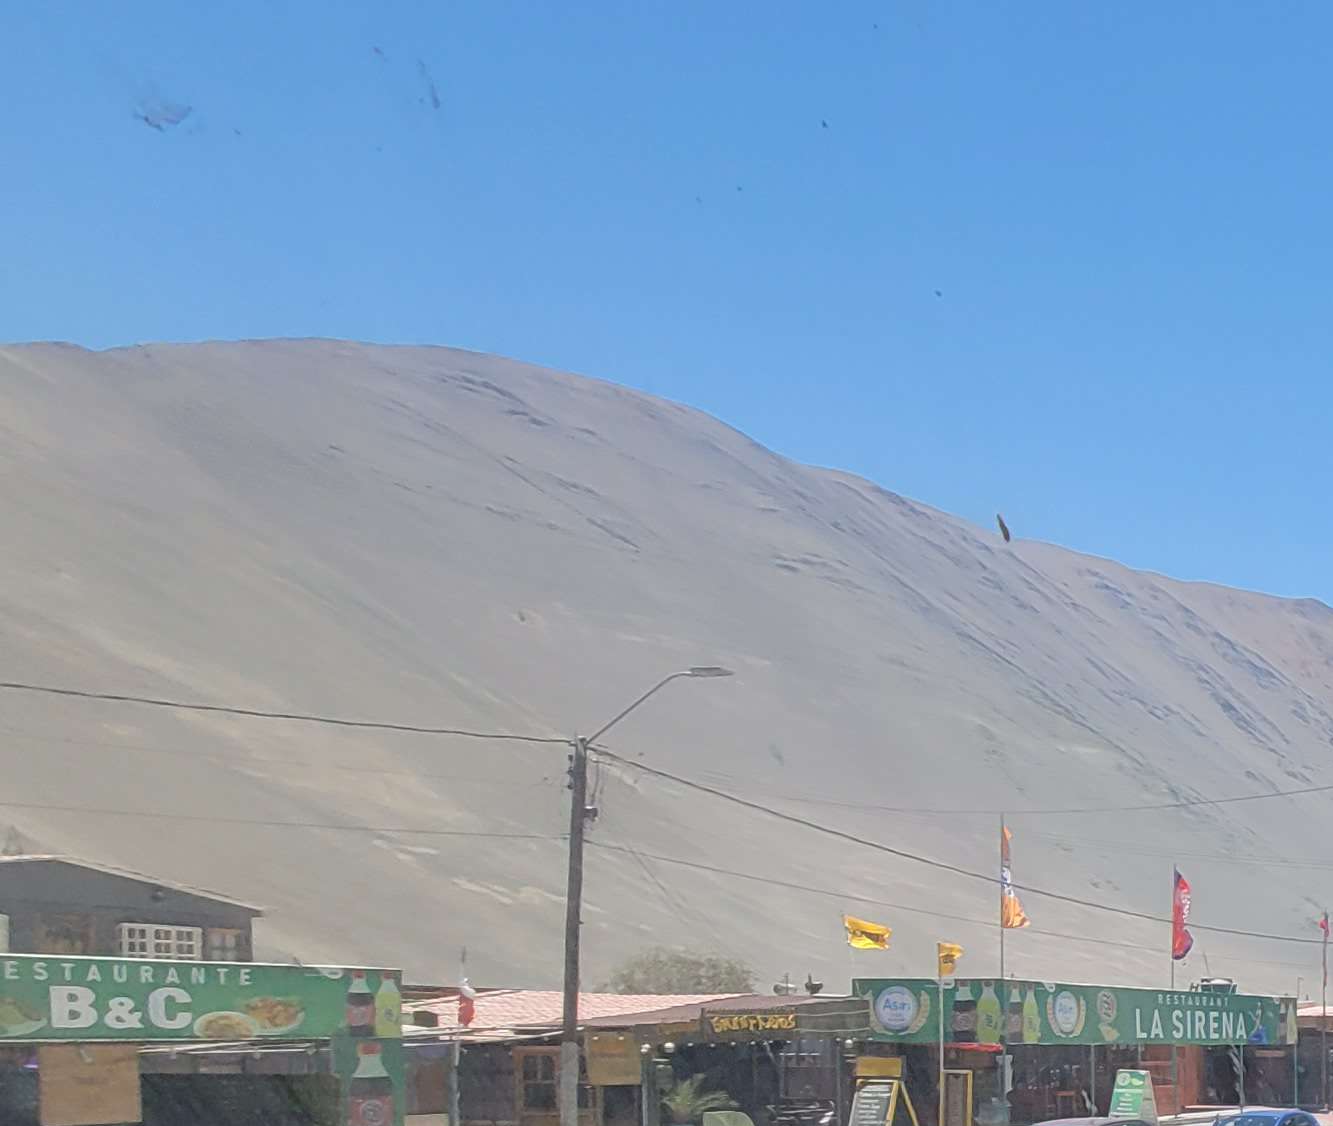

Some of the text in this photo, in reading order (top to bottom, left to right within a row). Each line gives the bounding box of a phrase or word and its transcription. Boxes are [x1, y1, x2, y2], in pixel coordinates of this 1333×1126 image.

[4, 960, 254, 986] ESTAURANTE
[49, 986, 193, 1029] B&C
[1135, 1008, 1247, 1039] LA SIRENA
